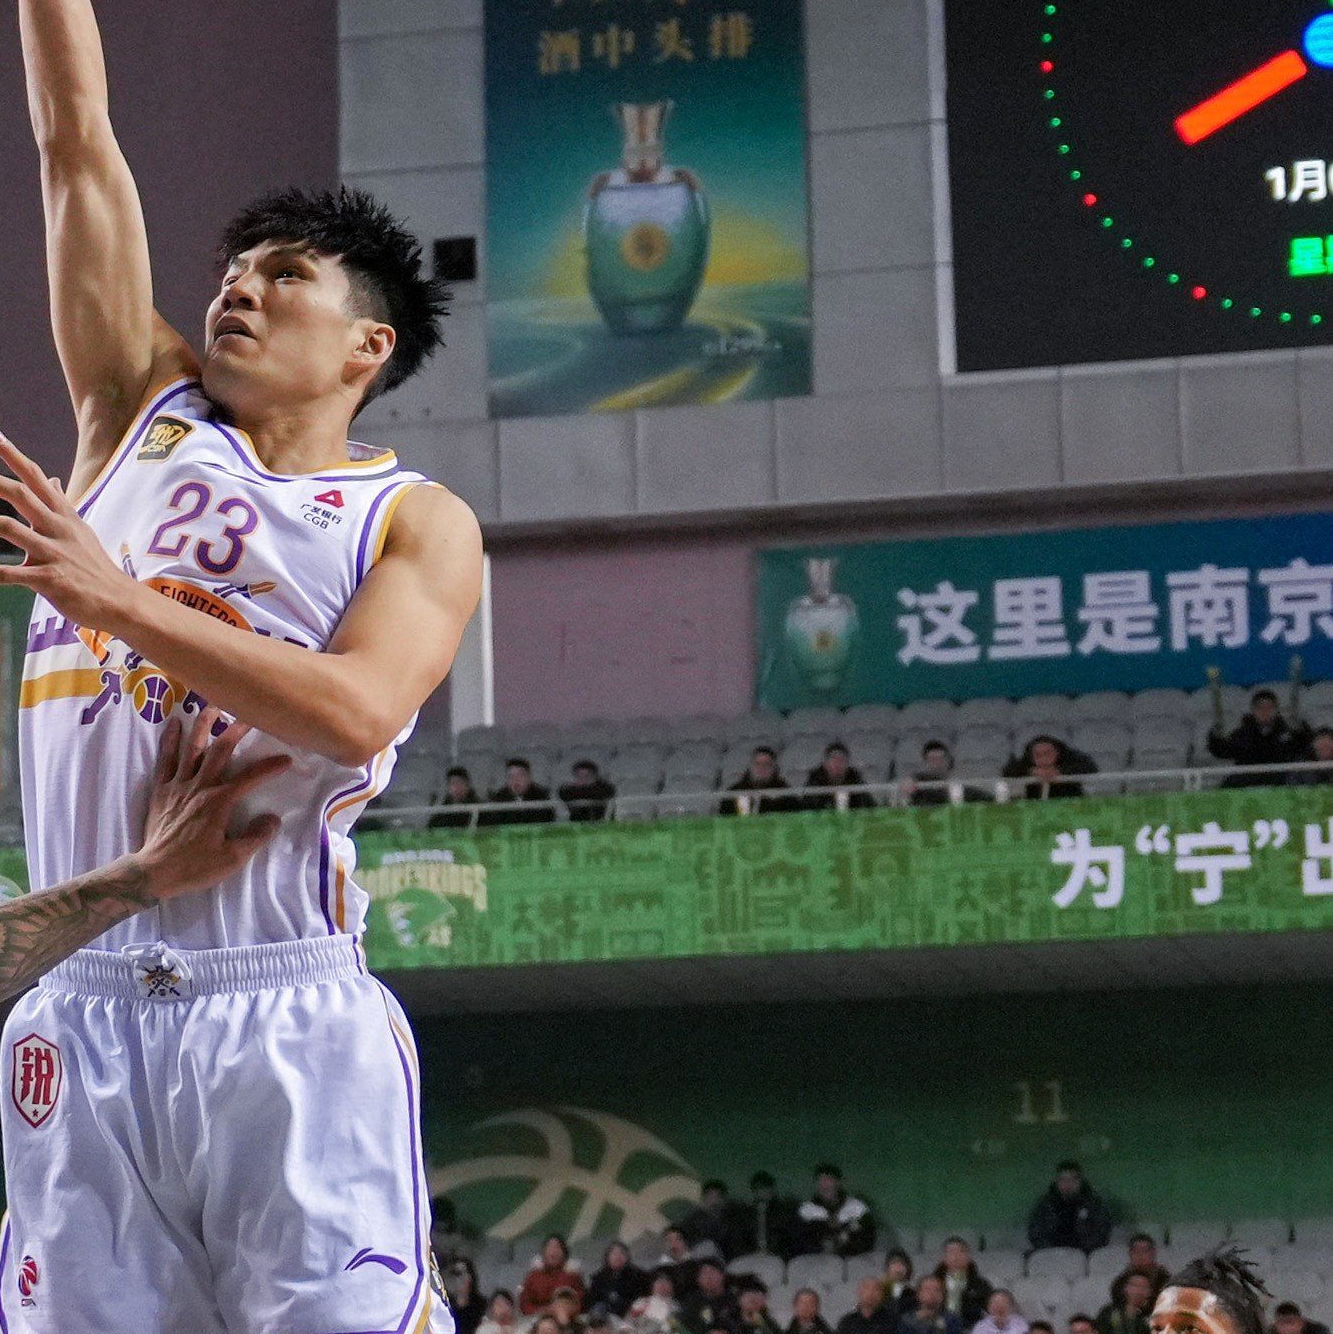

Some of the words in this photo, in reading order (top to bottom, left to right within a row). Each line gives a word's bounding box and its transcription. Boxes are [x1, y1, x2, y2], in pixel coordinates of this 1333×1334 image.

[1264, 160, 1333, 202] 1月
[1289, 235, 1333, 277] 星
[147, 482, 260, 575] 23
[303, 512, 329, 529] CGB
[896, 557, 1333, 665] 这里是南京
